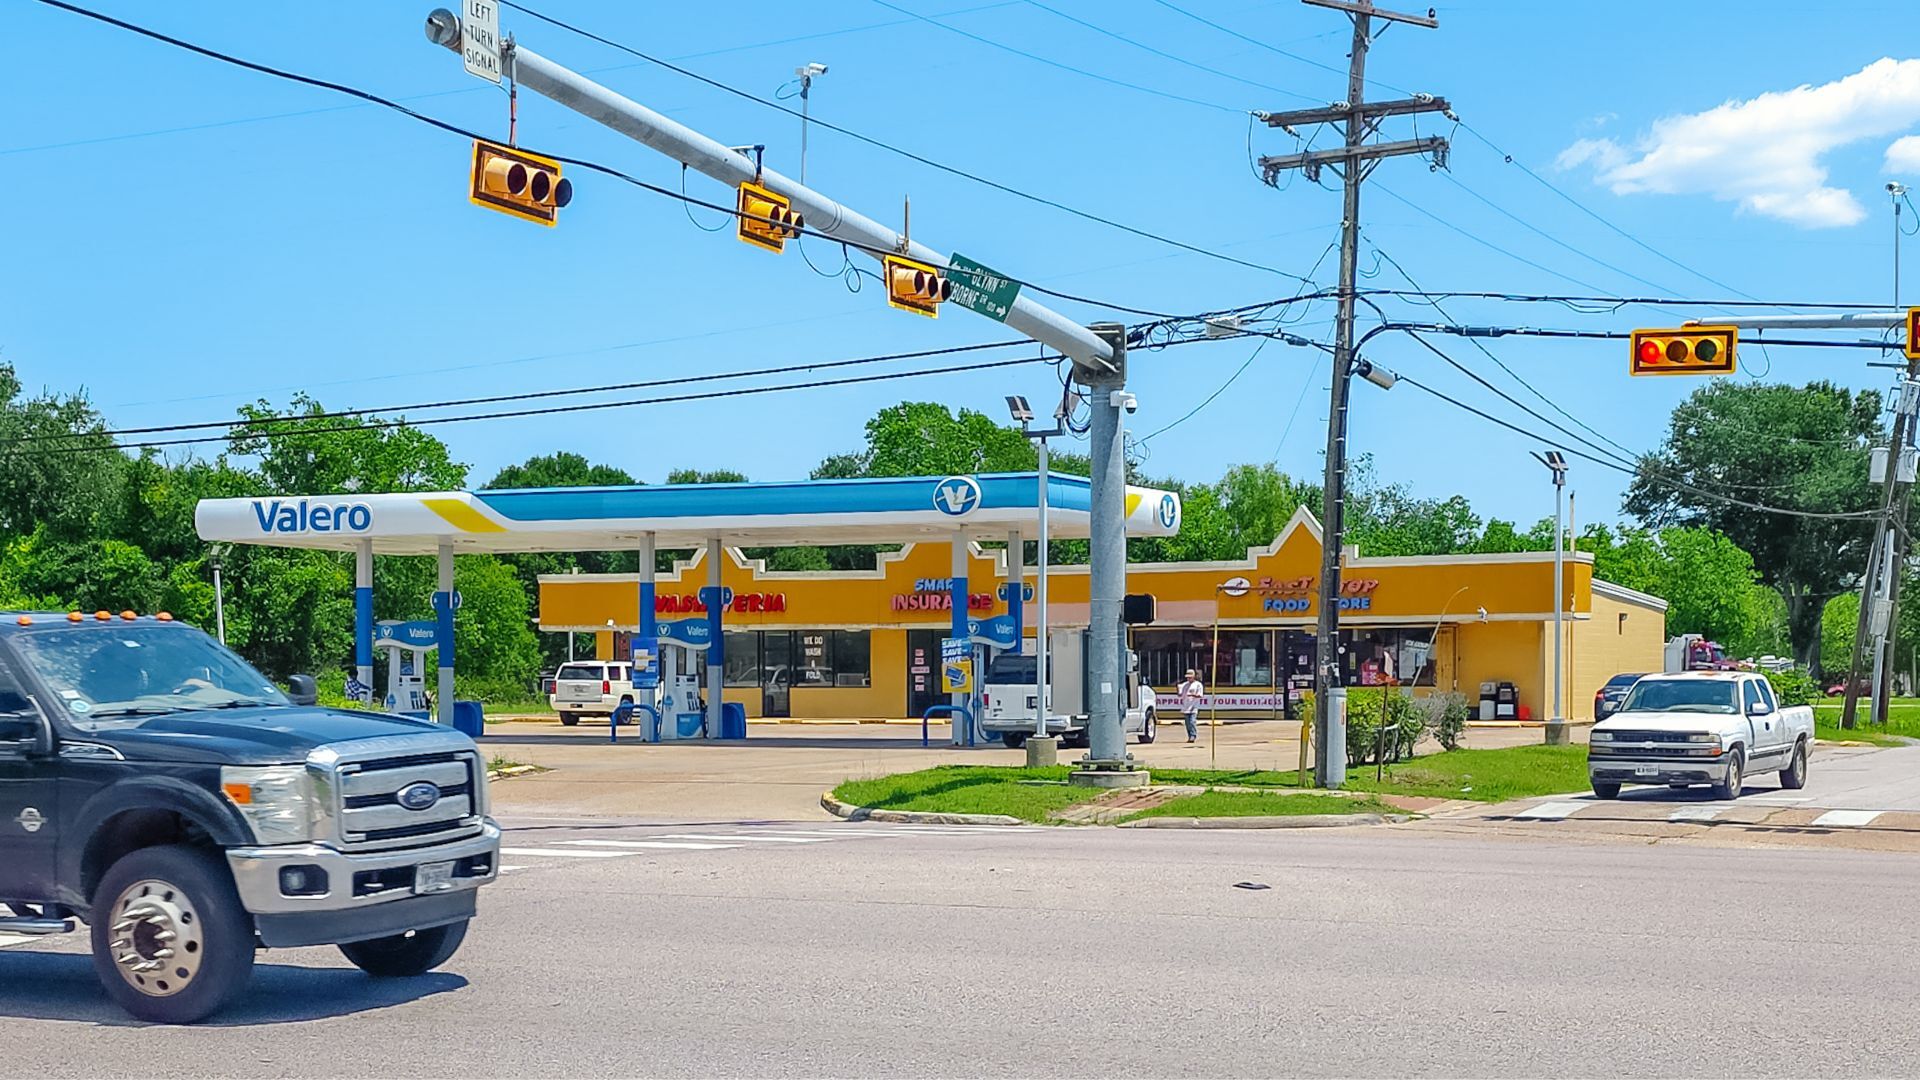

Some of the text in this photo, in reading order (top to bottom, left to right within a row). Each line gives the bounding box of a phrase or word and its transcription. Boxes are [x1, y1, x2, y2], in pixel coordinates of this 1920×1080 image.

[470, 0, 491, 22] LEFT
[469, 25, 493, 48] TURN
[466, 48, 498, 74] SIGNAL
[950, 281, 980, 309] BORNE
[253, 501, 371, 532] Valero
[915, 579, 953, 591] SMAR
[1339, 579, 1379, 594] TOP
[891, 594, 993, 610] INSURACE
[1263, 598, 1370, 612] FOOD ORE
[409, 628, 434, 637] Valero
[814, 636, 823, 644] DO
[942, 647, 961, 656] SAVE
